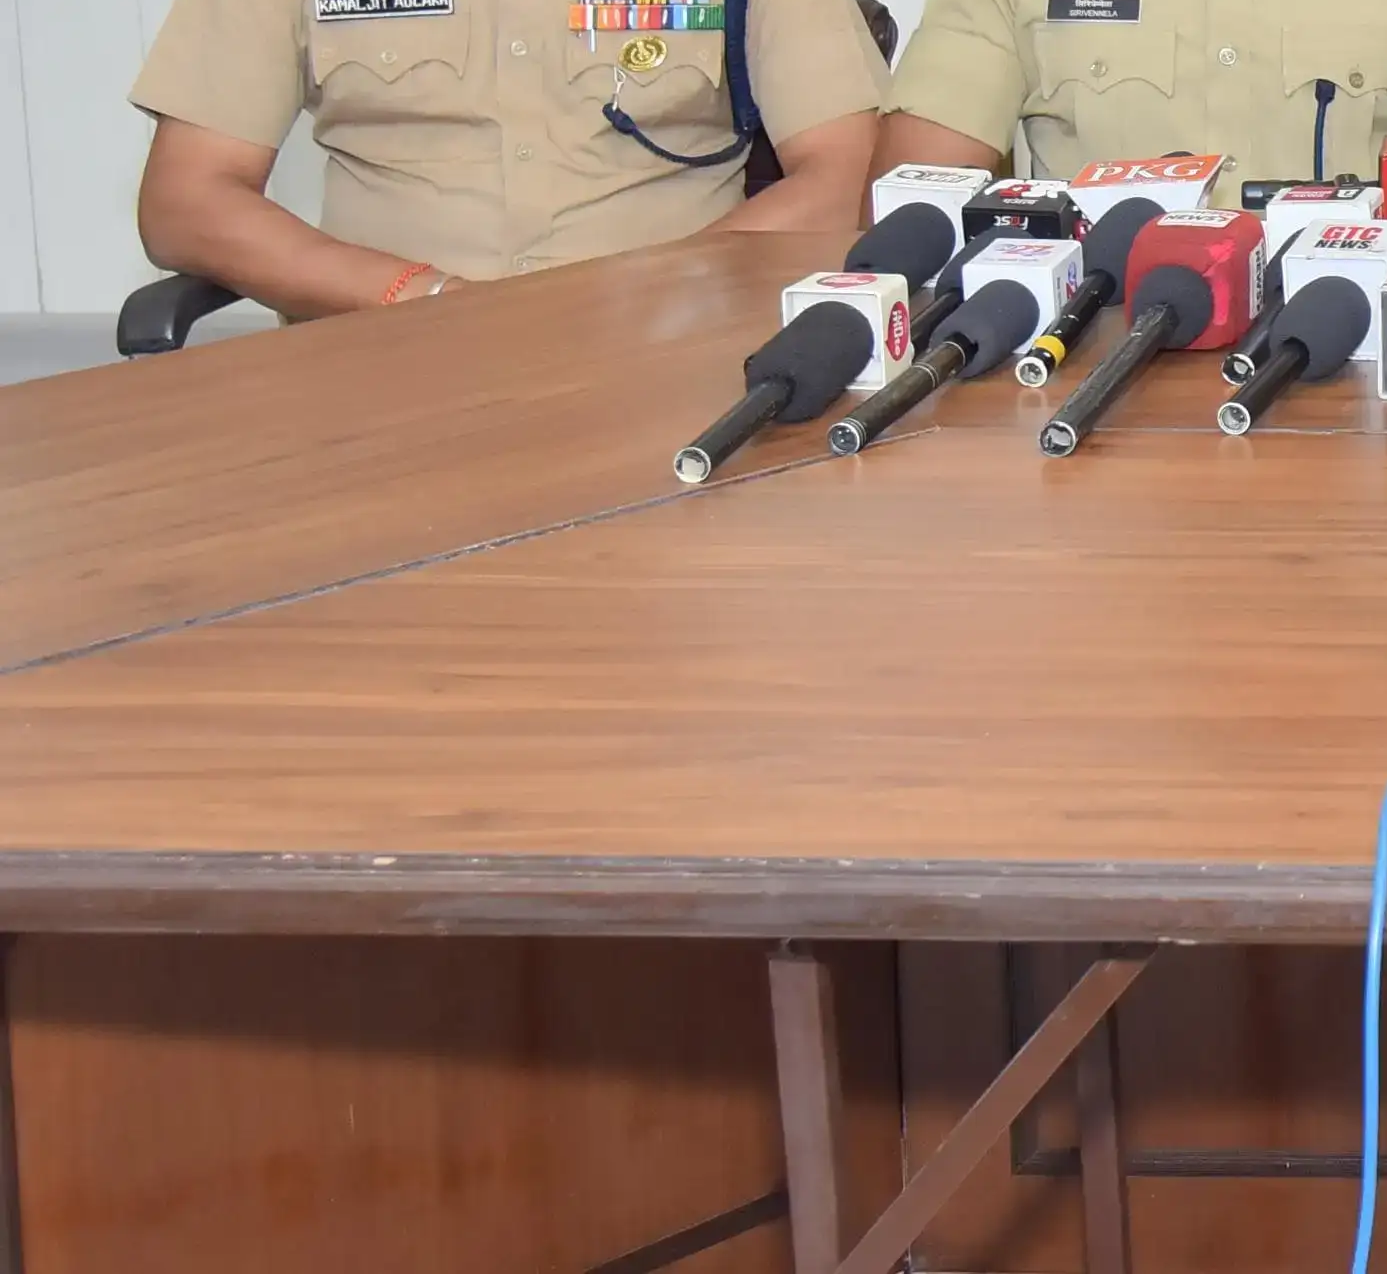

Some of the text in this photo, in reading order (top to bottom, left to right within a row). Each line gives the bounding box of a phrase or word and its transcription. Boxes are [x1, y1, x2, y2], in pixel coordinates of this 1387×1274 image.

[1088, 161, 1206, 183] PKG
[1321, 226, 1384, 241] GTC
[1313, 239, 1371, 250] NEWS
